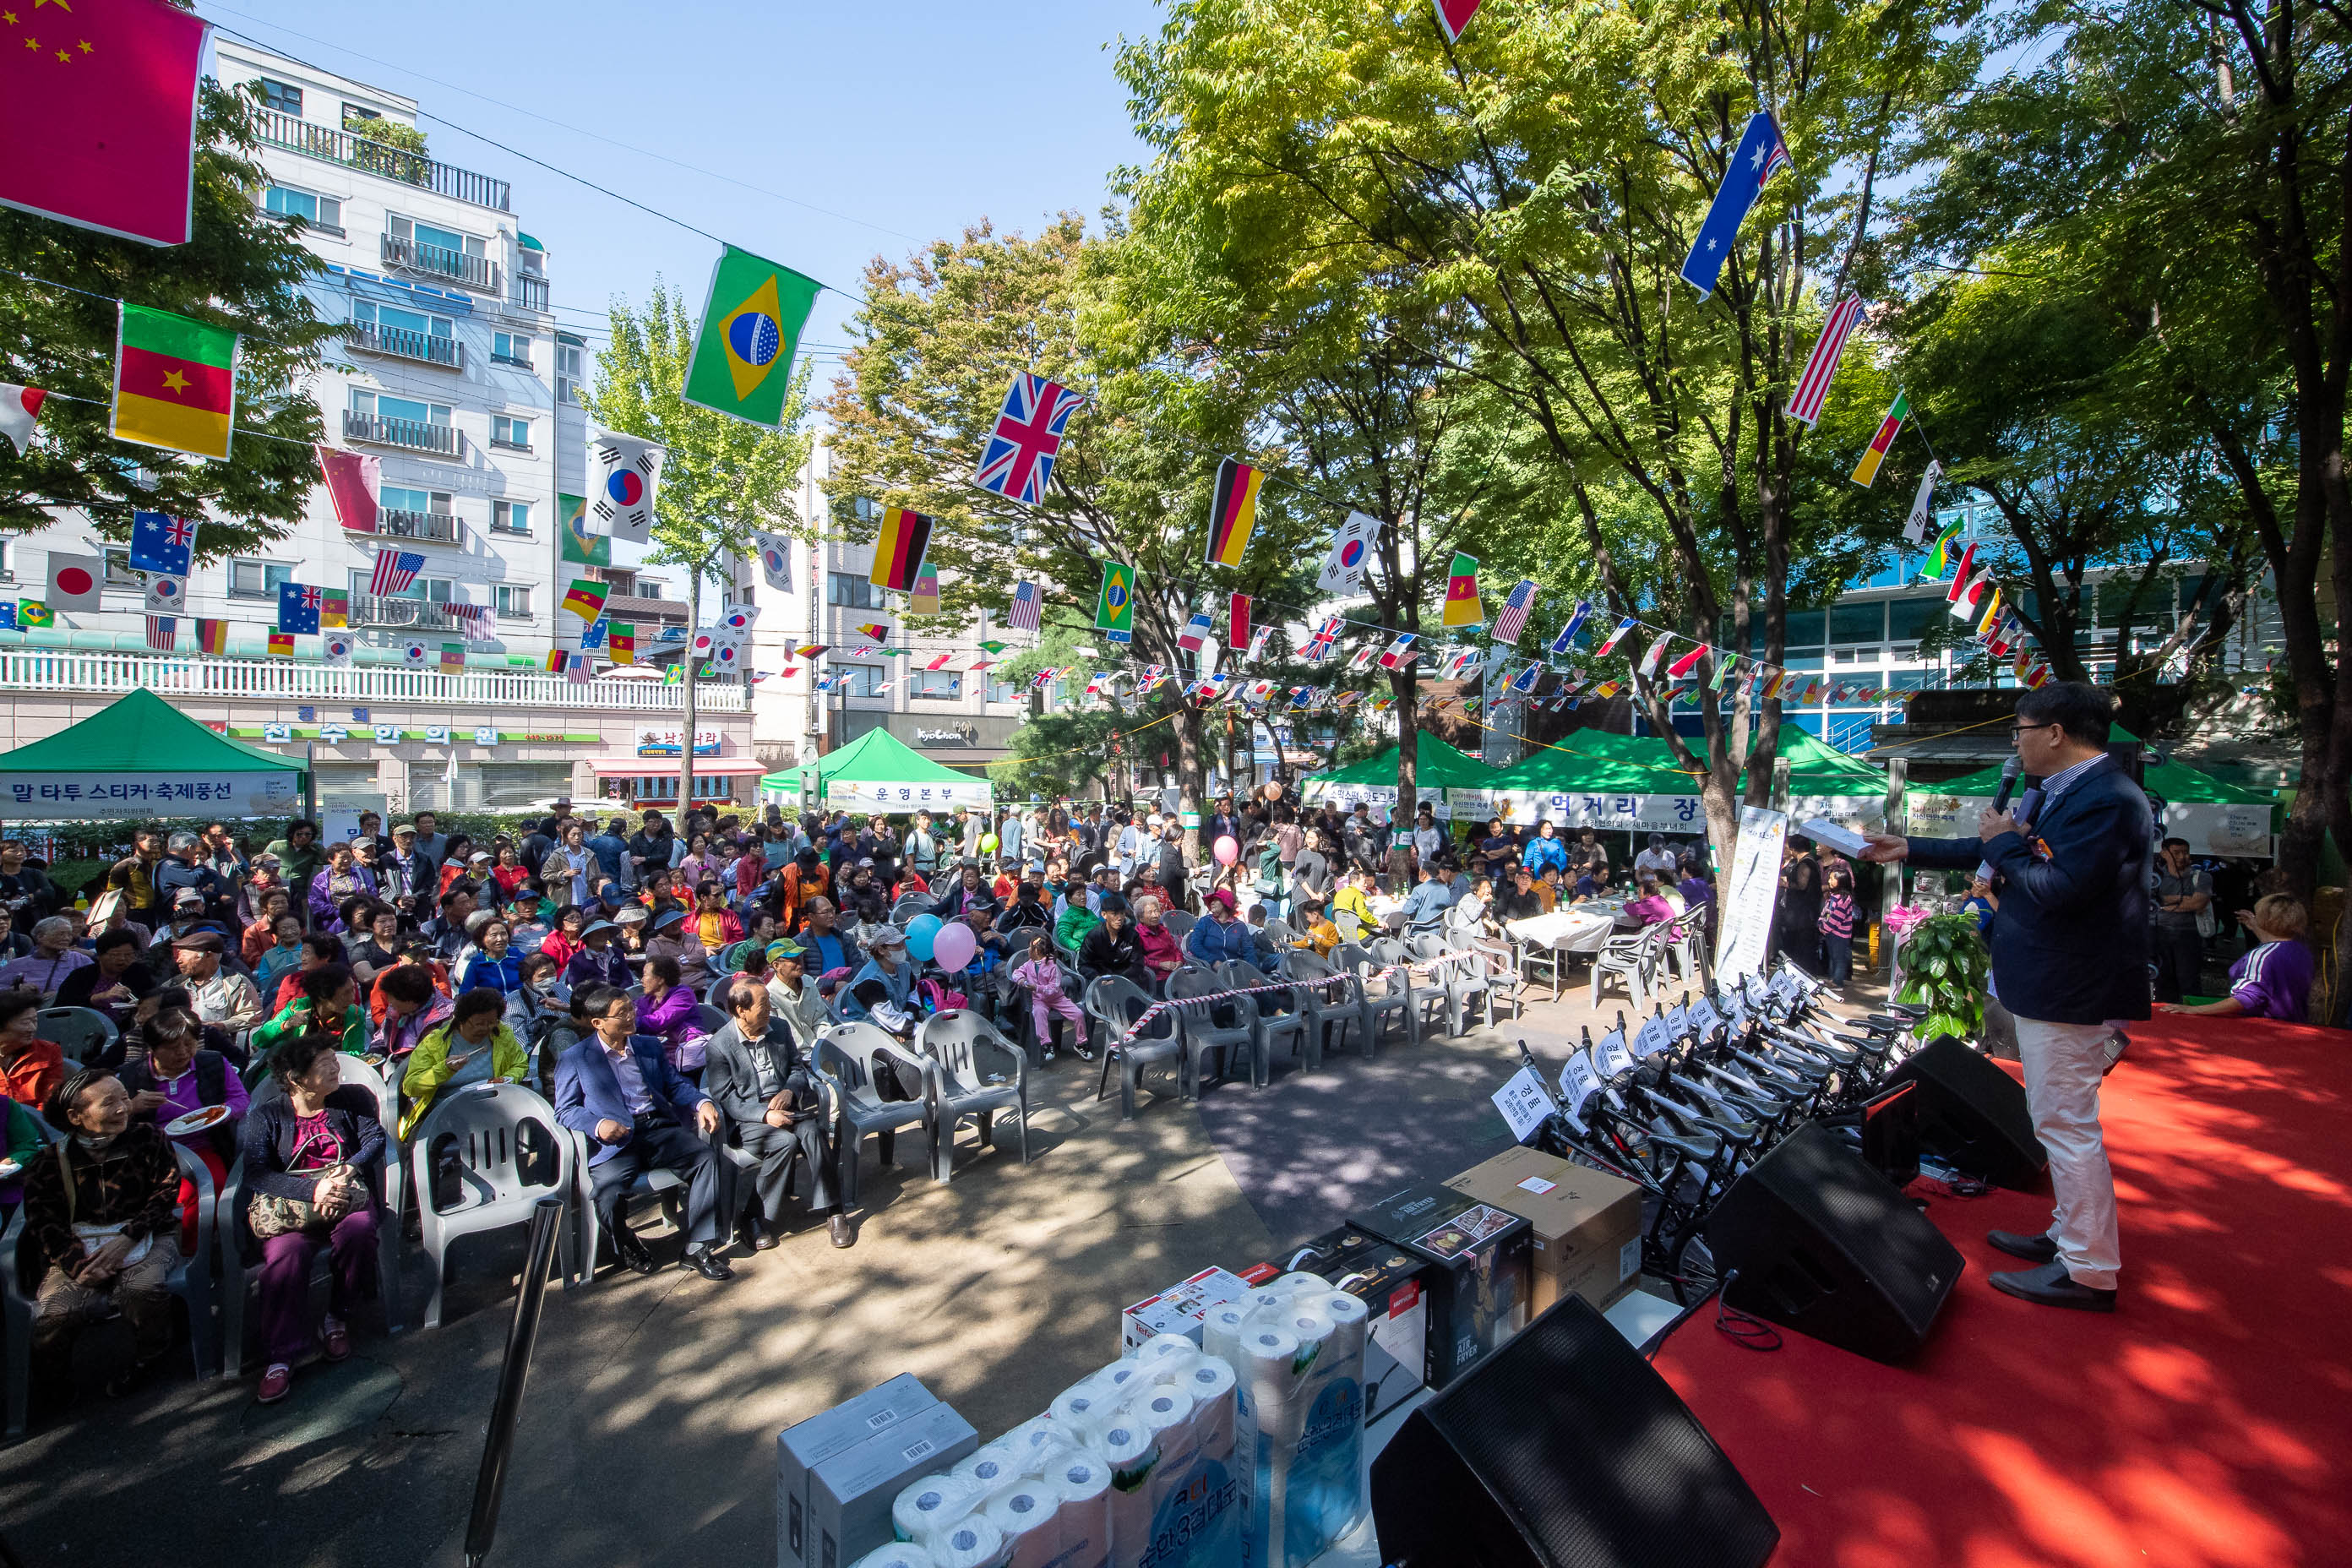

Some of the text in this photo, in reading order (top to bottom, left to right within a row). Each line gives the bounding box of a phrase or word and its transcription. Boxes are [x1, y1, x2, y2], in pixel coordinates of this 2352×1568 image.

[264, 721, 498, 747] 천수한의원
[13, 784, 34, 803] 말
[41, 784, 83, 802] 타투
[876, 788, 953, 801] 운영본부
[1551, 795, 1636, 818] 먹거리
[1631, 820, 1688, 831] 새마을부녀회
[1573, 1064, 1589, 1086] 경품
[1521, 1083, 1542, 1110] 경품
[1456, 1344, 1478, 1365] FRYER
[1457, 1339, 1471, 1355] AIR
